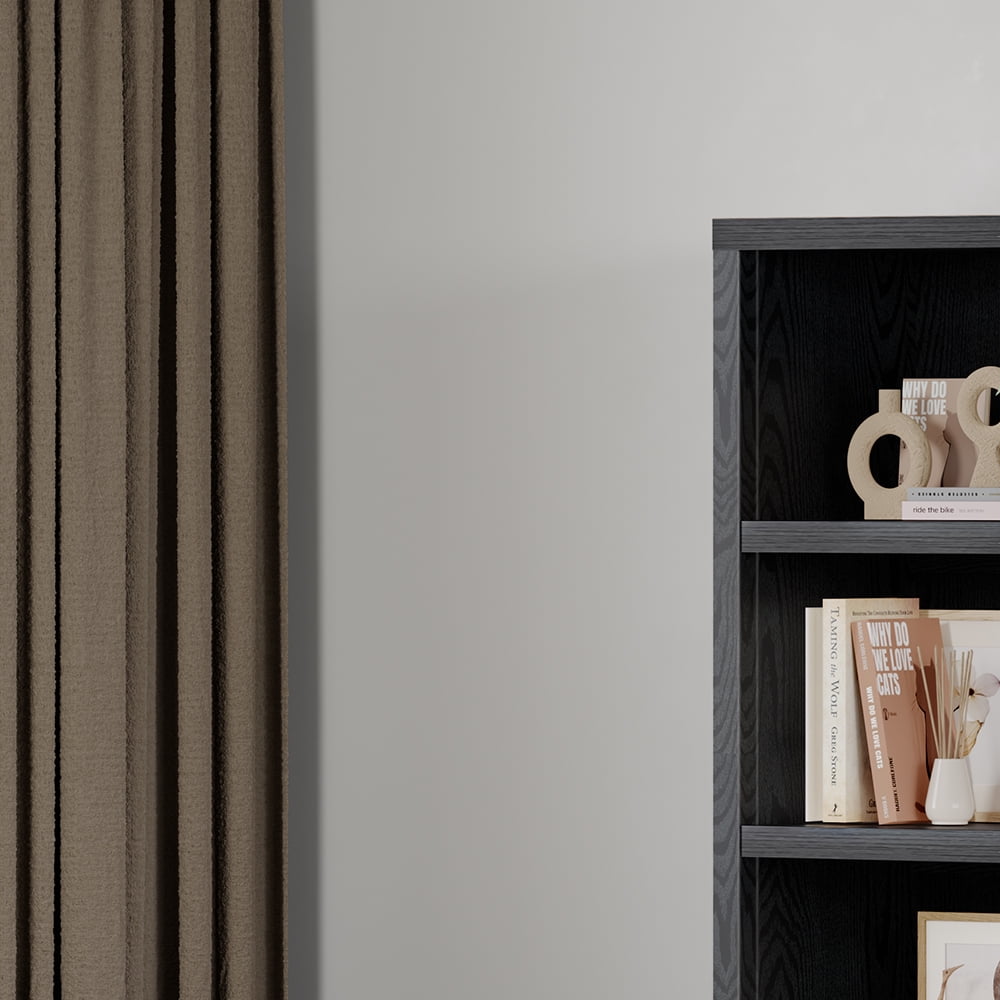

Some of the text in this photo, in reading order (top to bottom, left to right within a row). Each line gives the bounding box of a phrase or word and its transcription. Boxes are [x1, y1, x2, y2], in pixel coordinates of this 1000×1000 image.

[902, 380, 947, 398] WHY DO
[902, 399, 947, 416] WE LOVE
[830, 606, 840, 660] TAMING
[866, 621, 910, 647] WHY DO
[871, 648, 914, 672] WE LOVE
[876, 672, 901, 696] CATS
[830, 680, 840, 718] WOLF
[831, 726, 839, 753] GREG
[865, 686, 884, 769] WHY DO WE LOVE CATS
[831, 755, 839, 786] STONE
